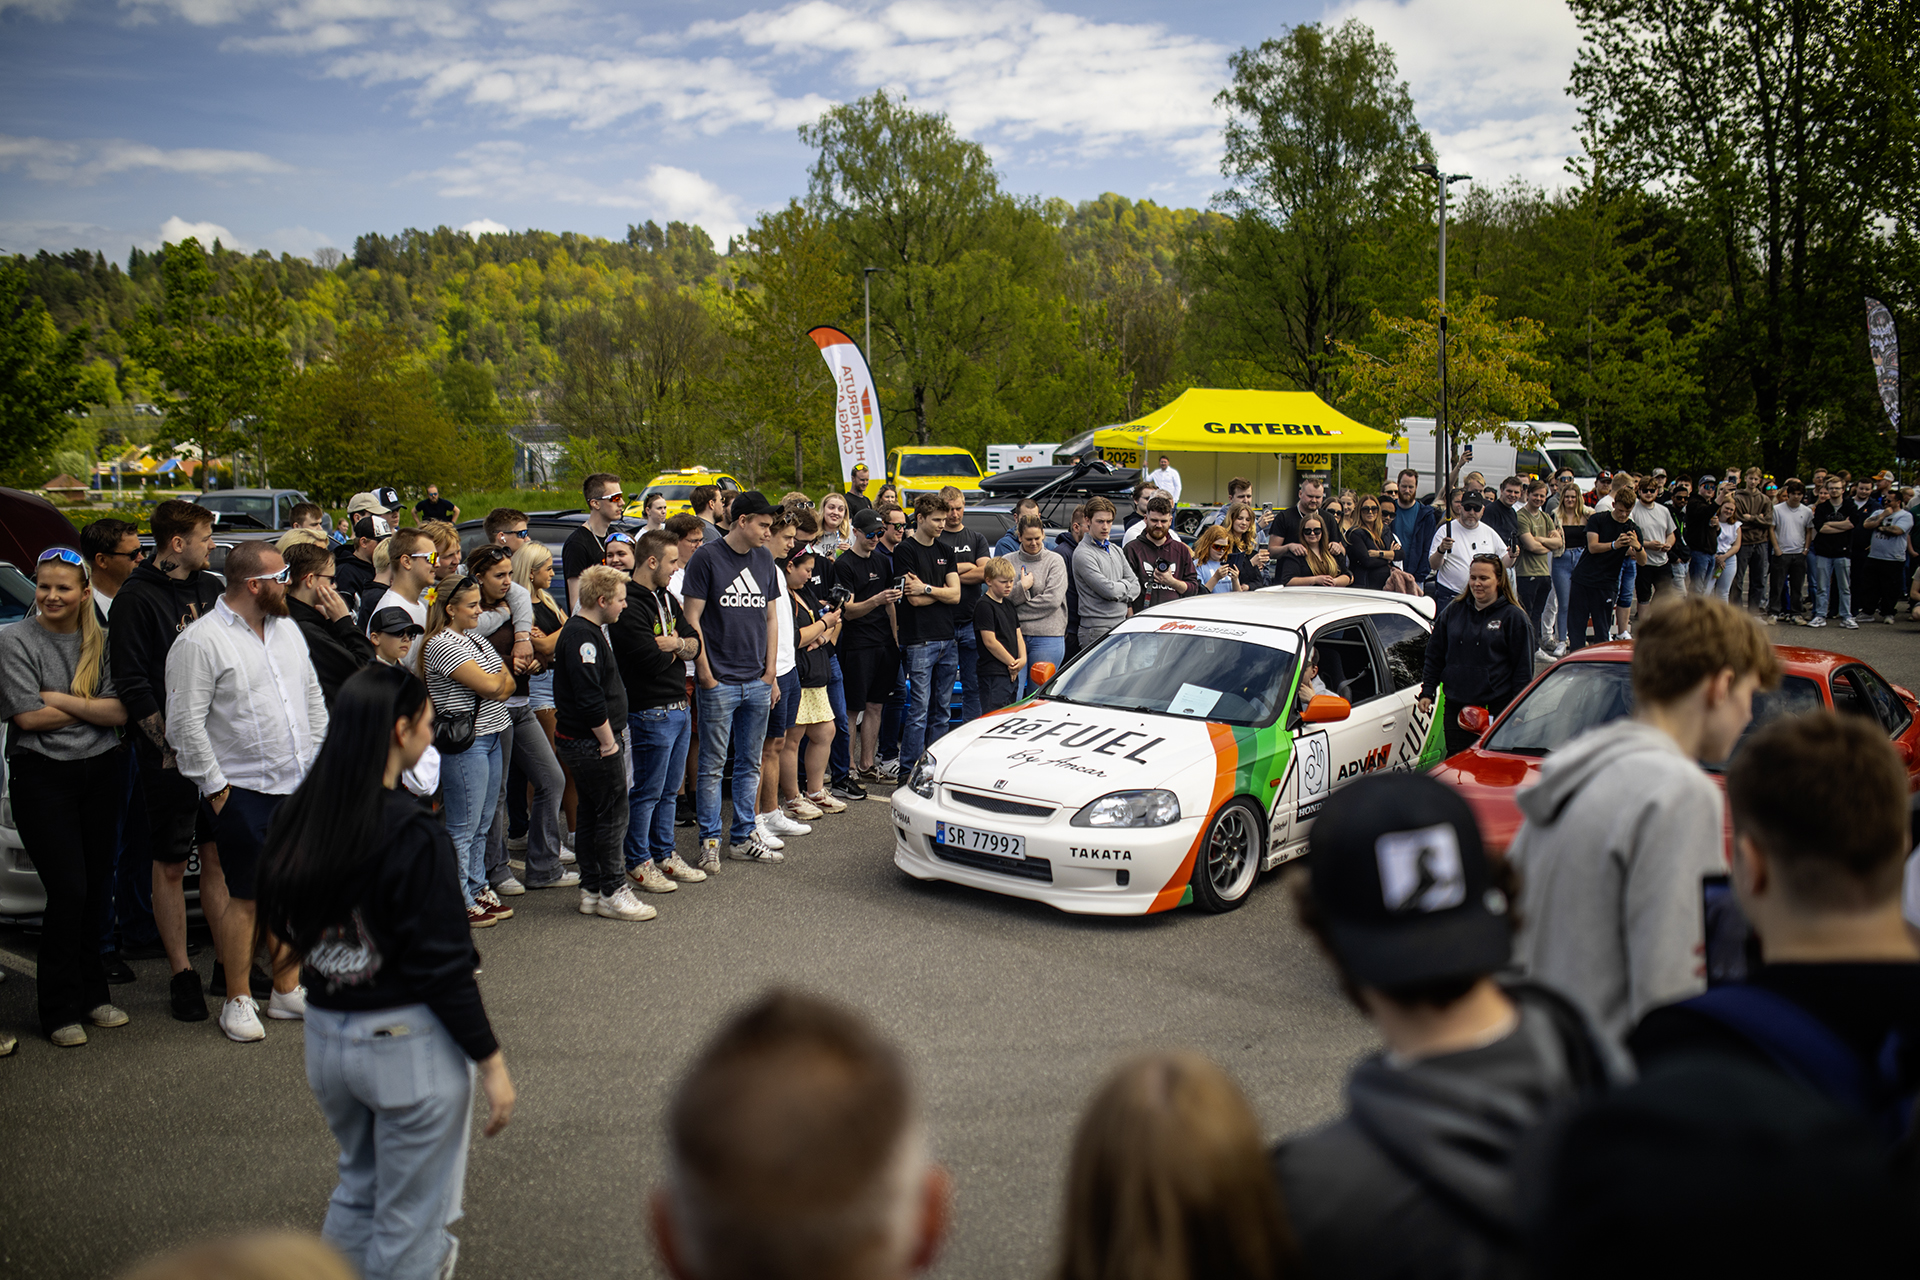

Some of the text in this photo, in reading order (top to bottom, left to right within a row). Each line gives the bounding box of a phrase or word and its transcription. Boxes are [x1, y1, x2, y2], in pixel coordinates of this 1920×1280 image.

[1204, 422, 1331, 436] GATEBIL
[1106, 451, 1137, 464] 2025
[1299, 453, 1328, 464] 2025
[720, 593, 766, 608] adidas
[1337, 750, 1388, 781] ADVAN
[1298, 802, 1322, 817] HOND
[948, 826, 1020, 856] SR 77992
[1070, 847, 1132, 861] TAKATA
